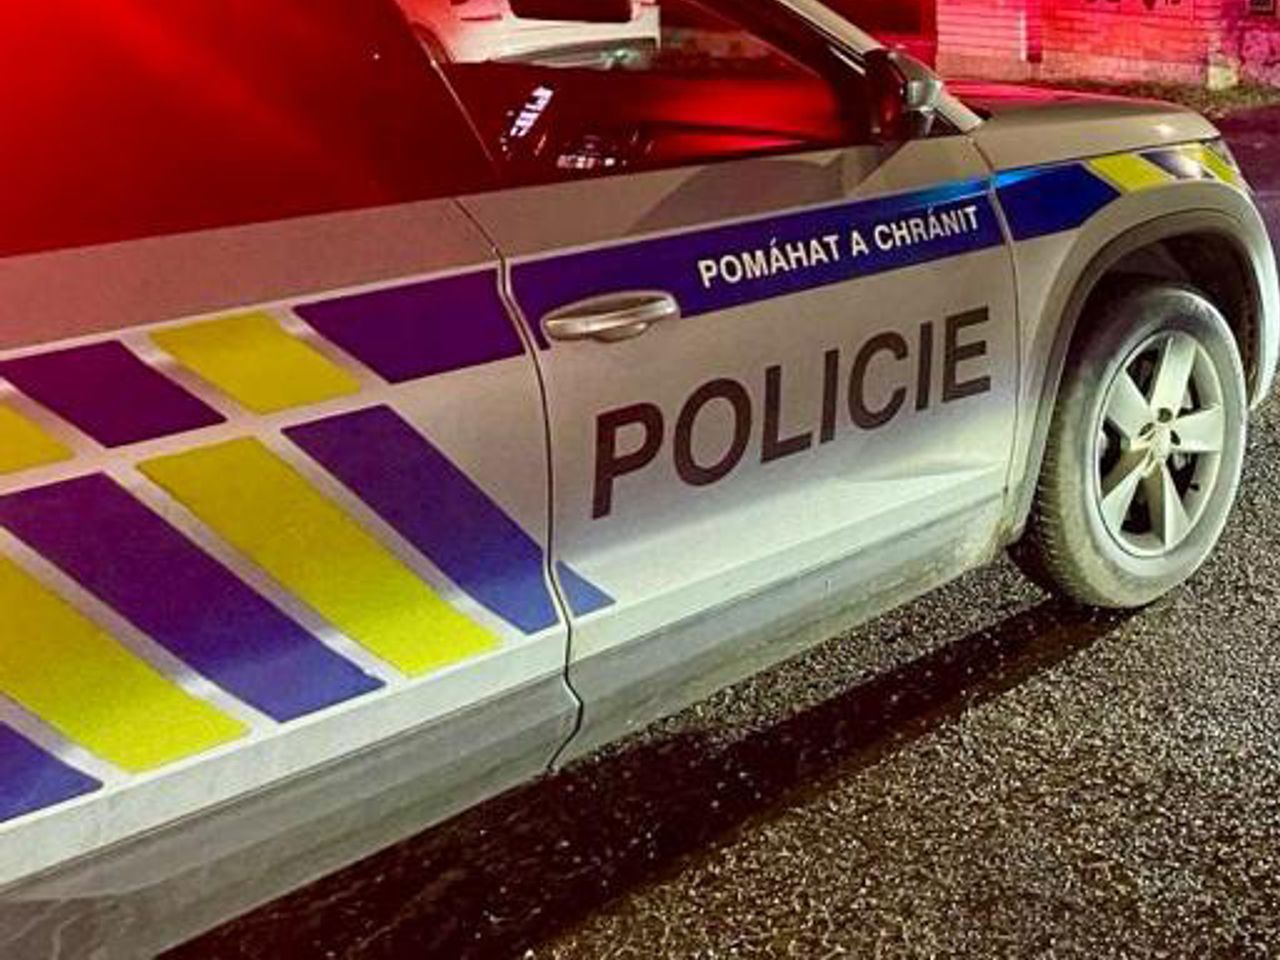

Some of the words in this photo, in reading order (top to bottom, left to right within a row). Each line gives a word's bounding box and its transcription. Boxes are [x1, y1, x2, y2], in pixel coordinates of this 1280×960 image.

[698, 238, 839, 288] POMÁHAT
[852, 230, 869, 256] A
[874, 205, 979, 250] CHRÁNIT
[592, 306, 991, 519] POLICIE
